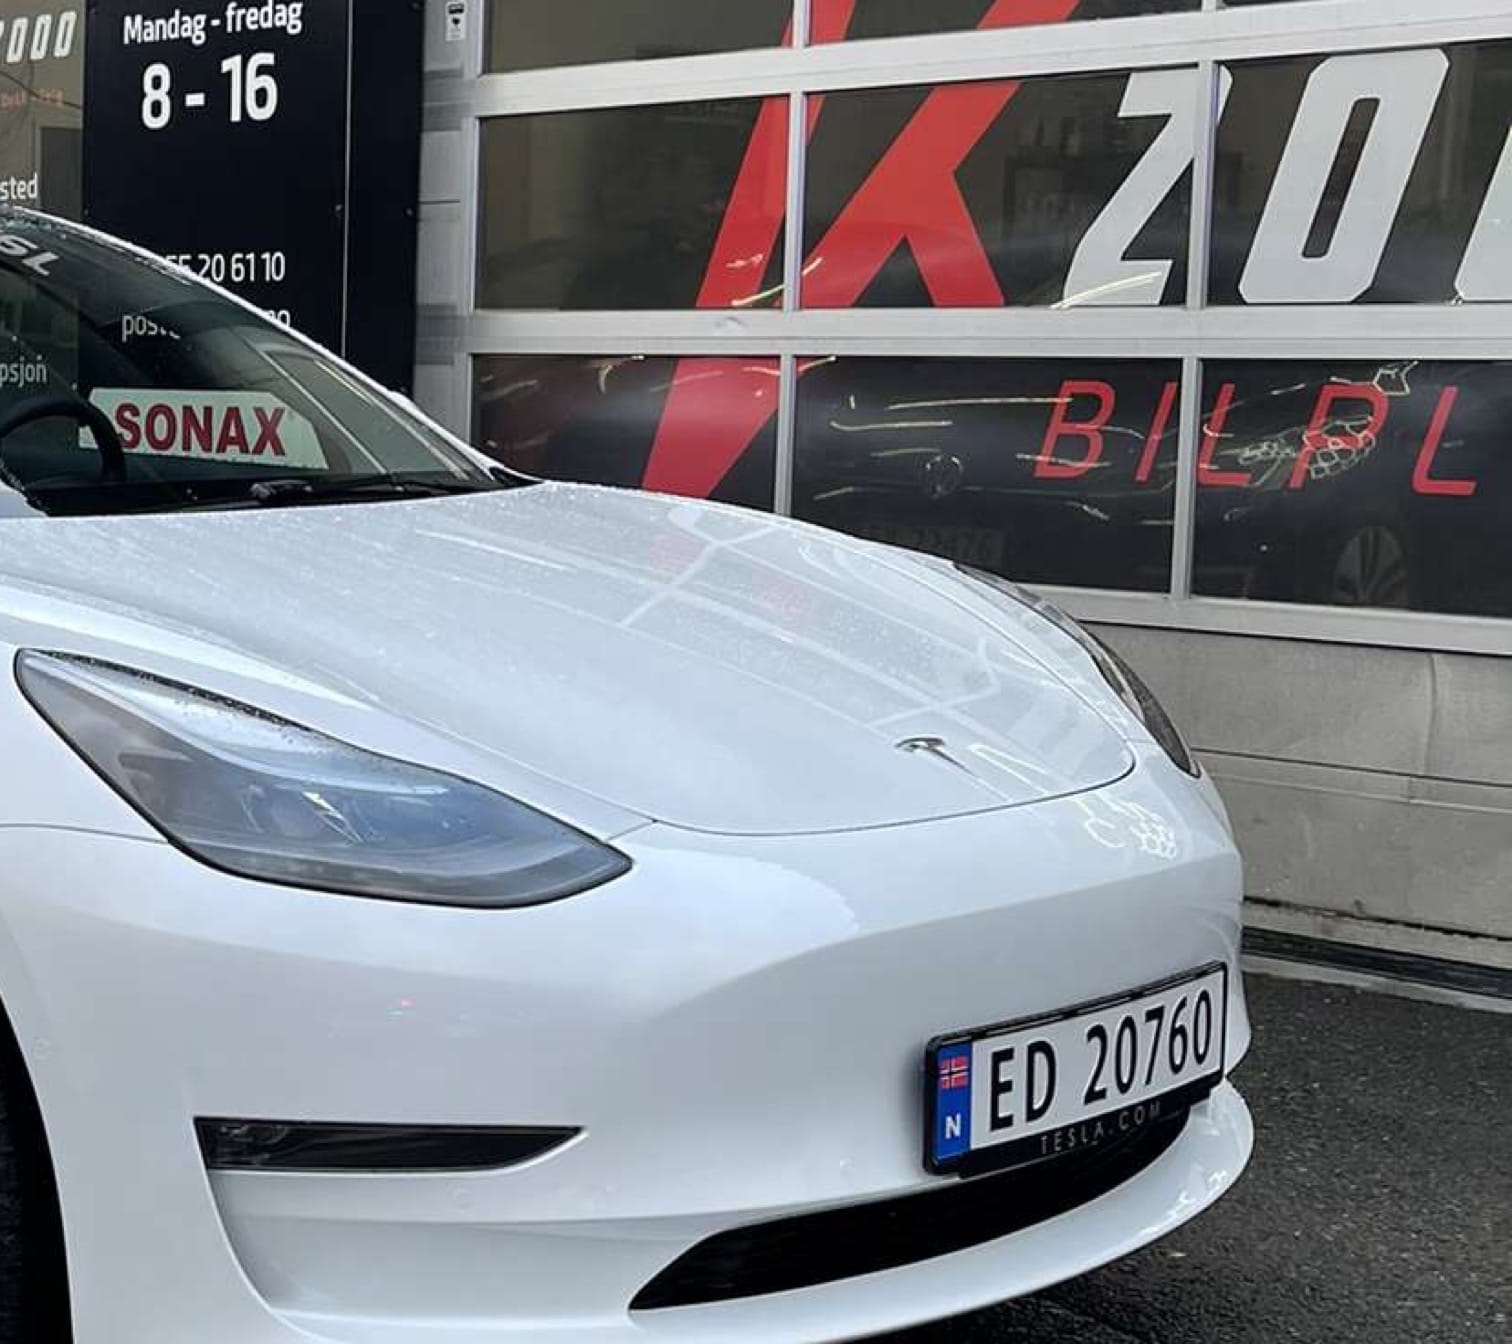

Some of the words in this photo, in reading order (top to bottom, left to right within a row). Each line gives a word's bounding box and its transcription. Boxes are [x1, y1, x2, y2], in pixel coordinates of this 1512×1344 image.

[123, 8, 207, 46] Mandag
[142, 62, 172, 130] 8
[220, 51, 278, 123] 16
[115, 402, 287, 456] SONAX
[944, 1112, 962, 1140] N
[990, 1040, 1057, 1132] ED
[1083, 989, 1212, 1106] 20760
[1040, 1100, 1162, 1155] TESLA.COM
